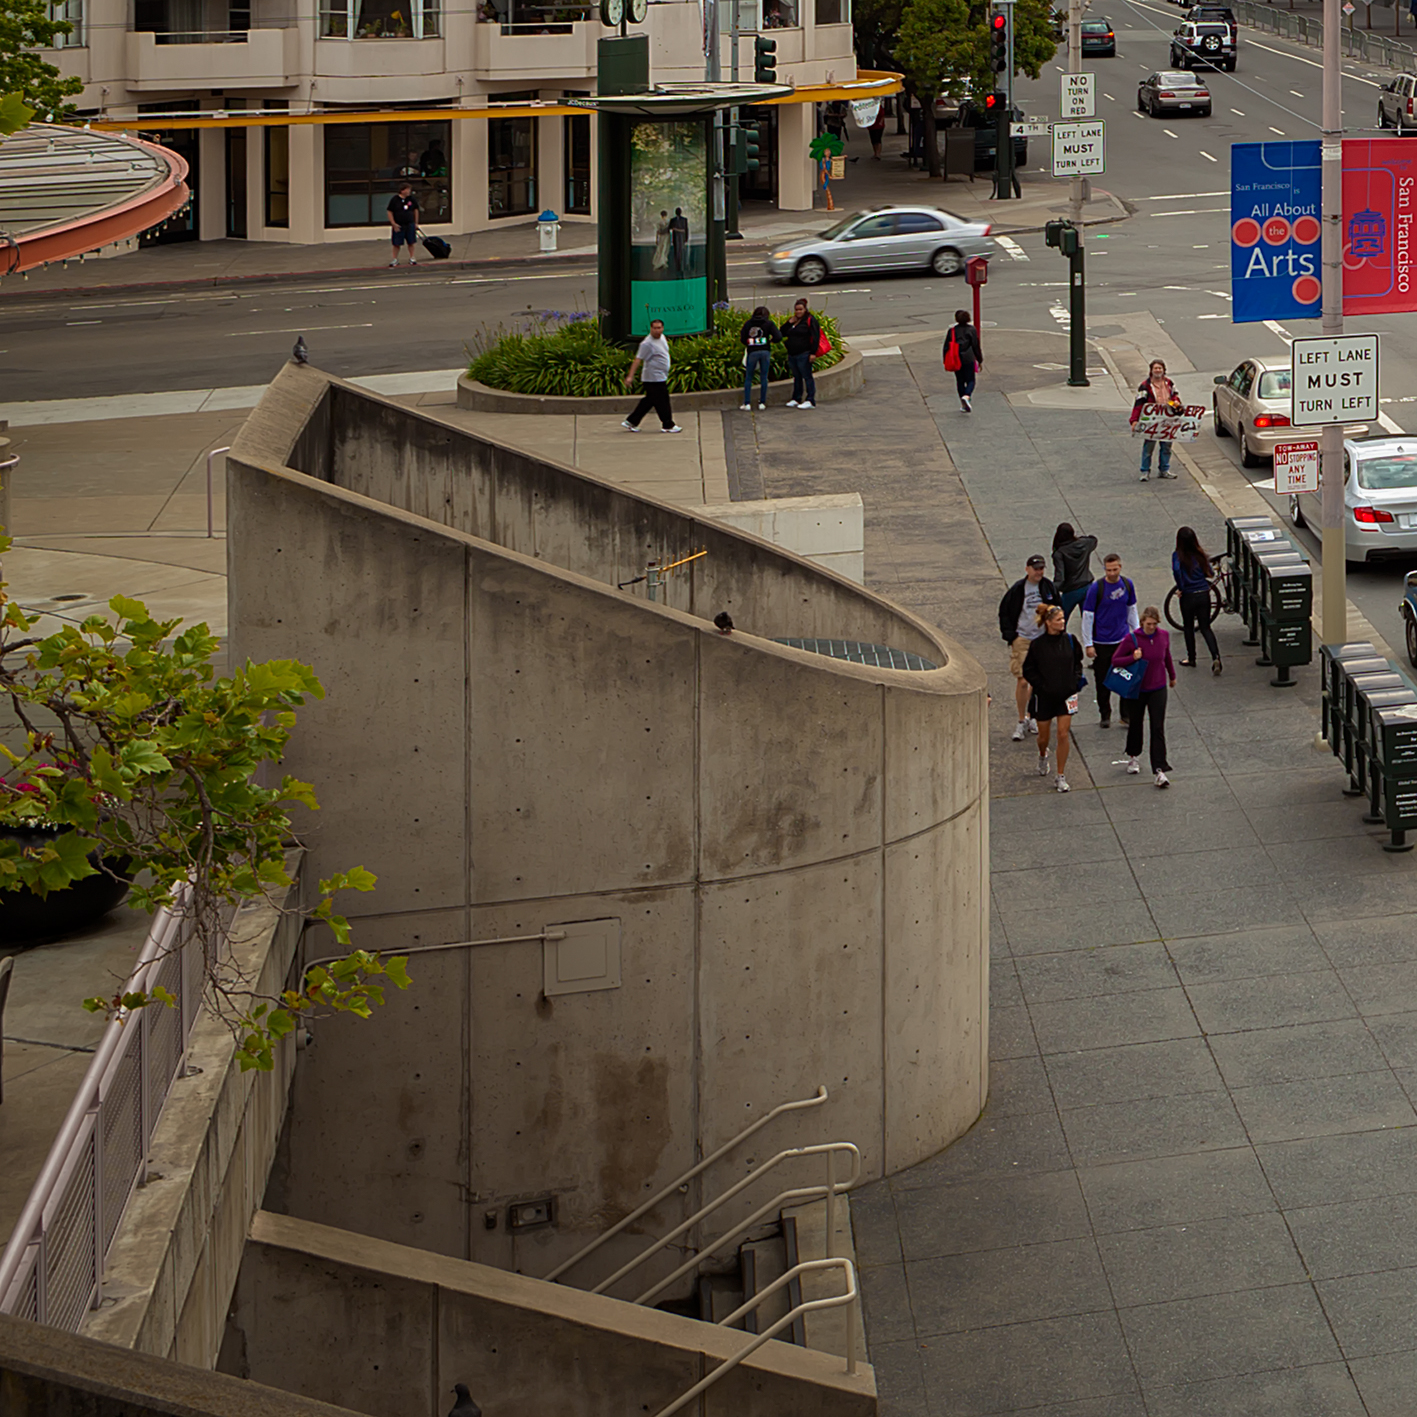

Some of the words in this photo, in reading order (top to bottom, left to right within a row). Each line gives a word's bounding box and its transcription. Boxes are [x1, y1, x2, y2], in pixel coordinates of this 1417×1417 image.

[1070, 76, 1087, 86] NO
[1067, 88, 1089, 96] TURN
[1072, 97, 1084, 105] ON
[1070, 107, 1087, 115] RED
[1057, 131, 1076, 140] LEFT
[1081, 129, 1102, 138] LANE
[1063, 143, 1094, 154] MUST
[1056, 160, 1076, 169] TURN
[1081, 158, 1100, 167] LEFT
[1235, 183, 1251, 192] San
[1253, 181, 1291, 191] Francisco
[1293, 187, 1300, 195] is
[1399, 176, 1415, 210] San
[1251, 204, 1270, 217] All
[1273, 202, 1316, 216] About
[1269, 226, 1285, 236] the
[1397, 214, 1414, 293] Francisco
[1244, 247, 1315, 279] Arts
[1299, 351, 1329, 365] LEFT
[1338, 348, 1372, 362] LANE
[1307, 372, 1364, 389] MUST
[1299, 398, 1333, 413] TURN
[1341, 395, 1372, 410] LEFT
[1278, 443, 1315, 452] TOW-AWAY
[1276, 453, 1288, 464] NO
[1289, 452, 1317, 463] STOPPING
[1289, 464, 1305, 473] ANY
[1288, 474, 1306, 484] TIME
